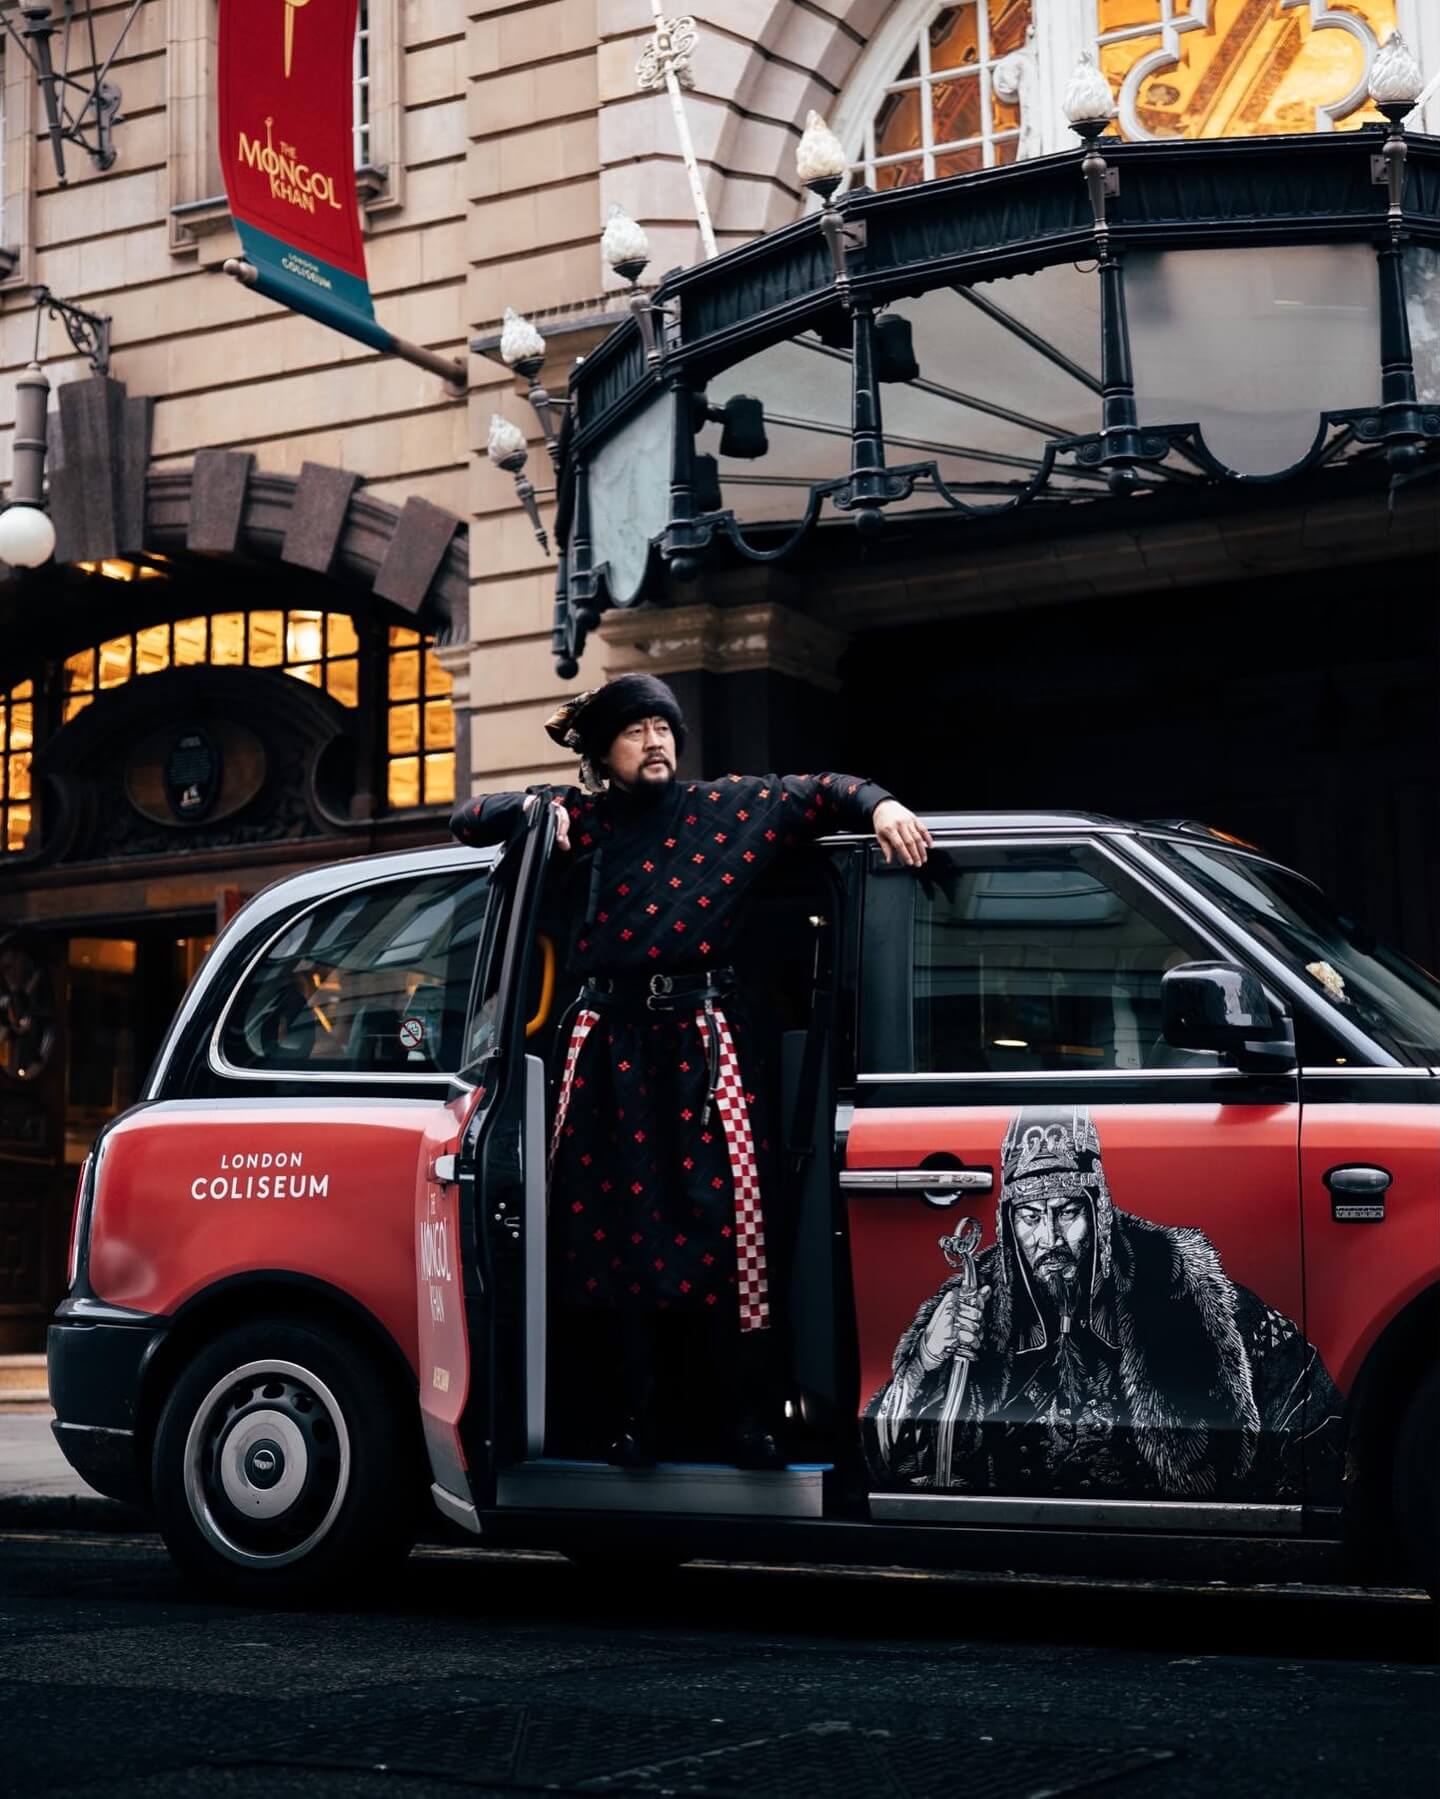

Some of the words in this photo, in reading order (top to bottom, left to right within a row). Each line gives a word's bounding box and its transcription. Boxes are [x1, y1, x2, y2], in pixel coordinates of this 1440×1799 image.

[280, 141, 297, 160] THE
[238, 132, 342, 209] MONGOL
[270, 177, 315, 214] KHAN
[221, 1152, 302, 1169] LONDON
[191, 1174, 329, 1200] COLISEUM
